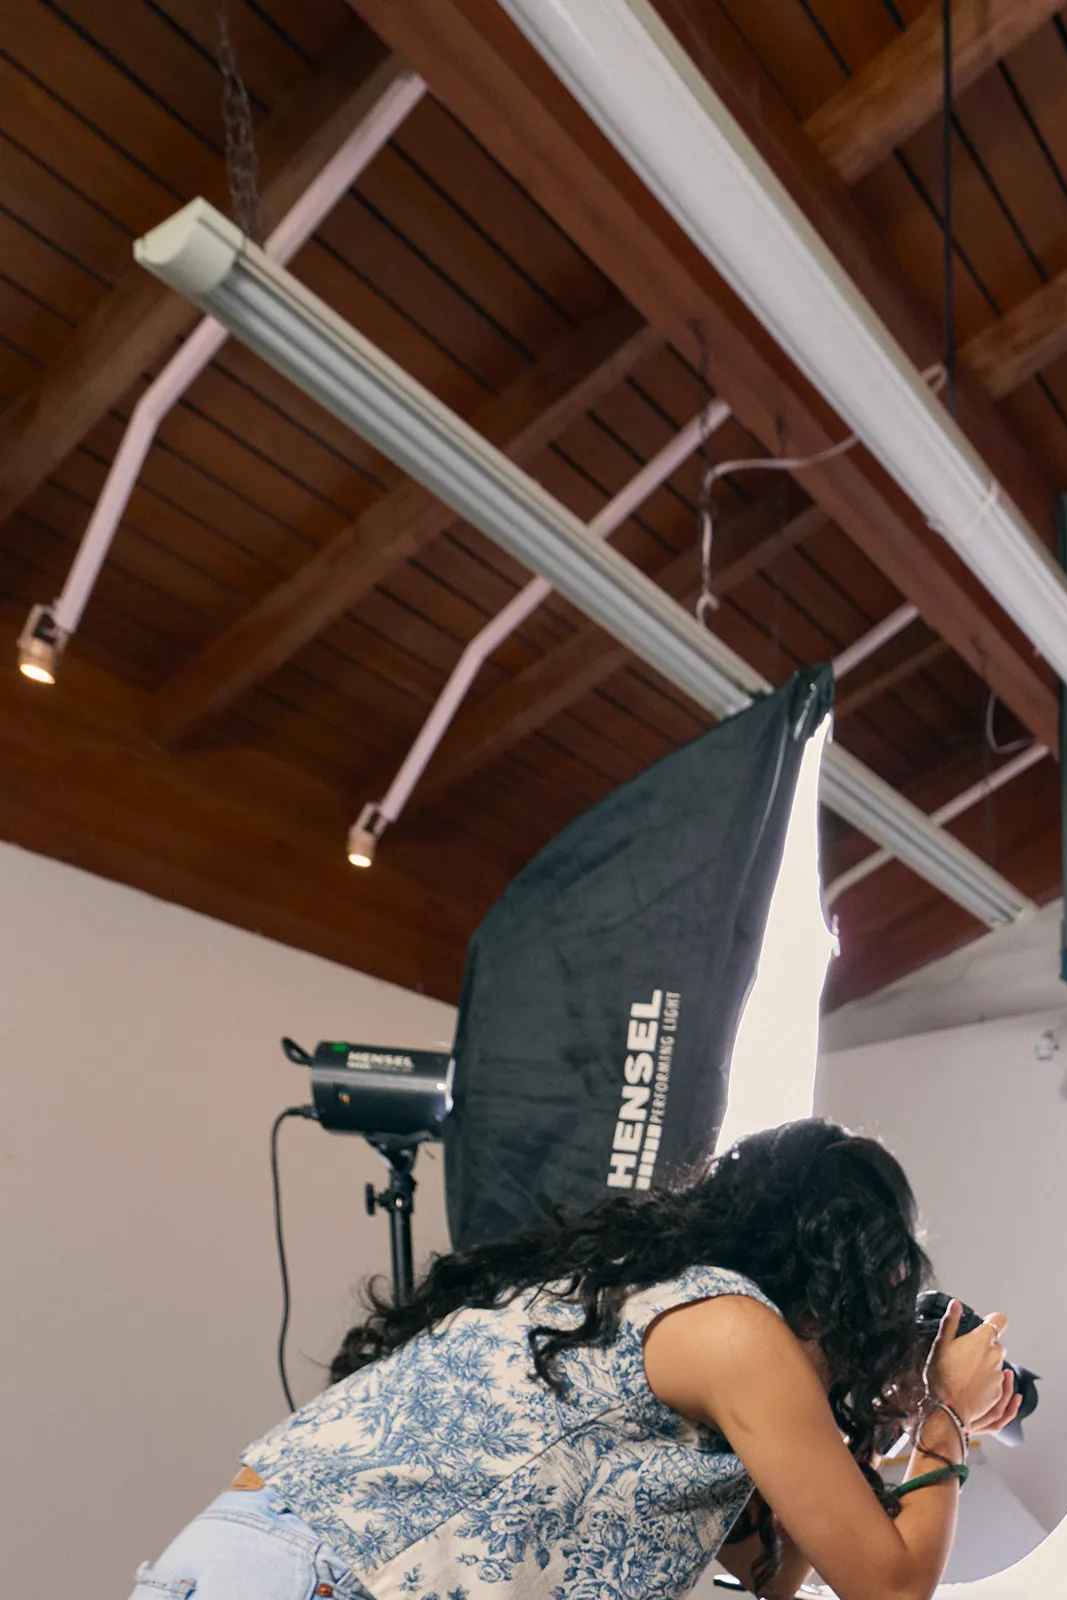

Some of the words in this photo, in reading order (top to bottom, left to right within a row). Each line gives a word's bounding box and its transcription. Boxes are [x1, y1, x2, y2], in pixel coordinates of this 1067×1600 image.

[348, 1051, 414, 1069] HENSEL
[607, 989, 662, 1188] HENSEL
[649, 1035, 675, 1125] PERFORMING
[662, 991, 680, 1032] LIGHT
